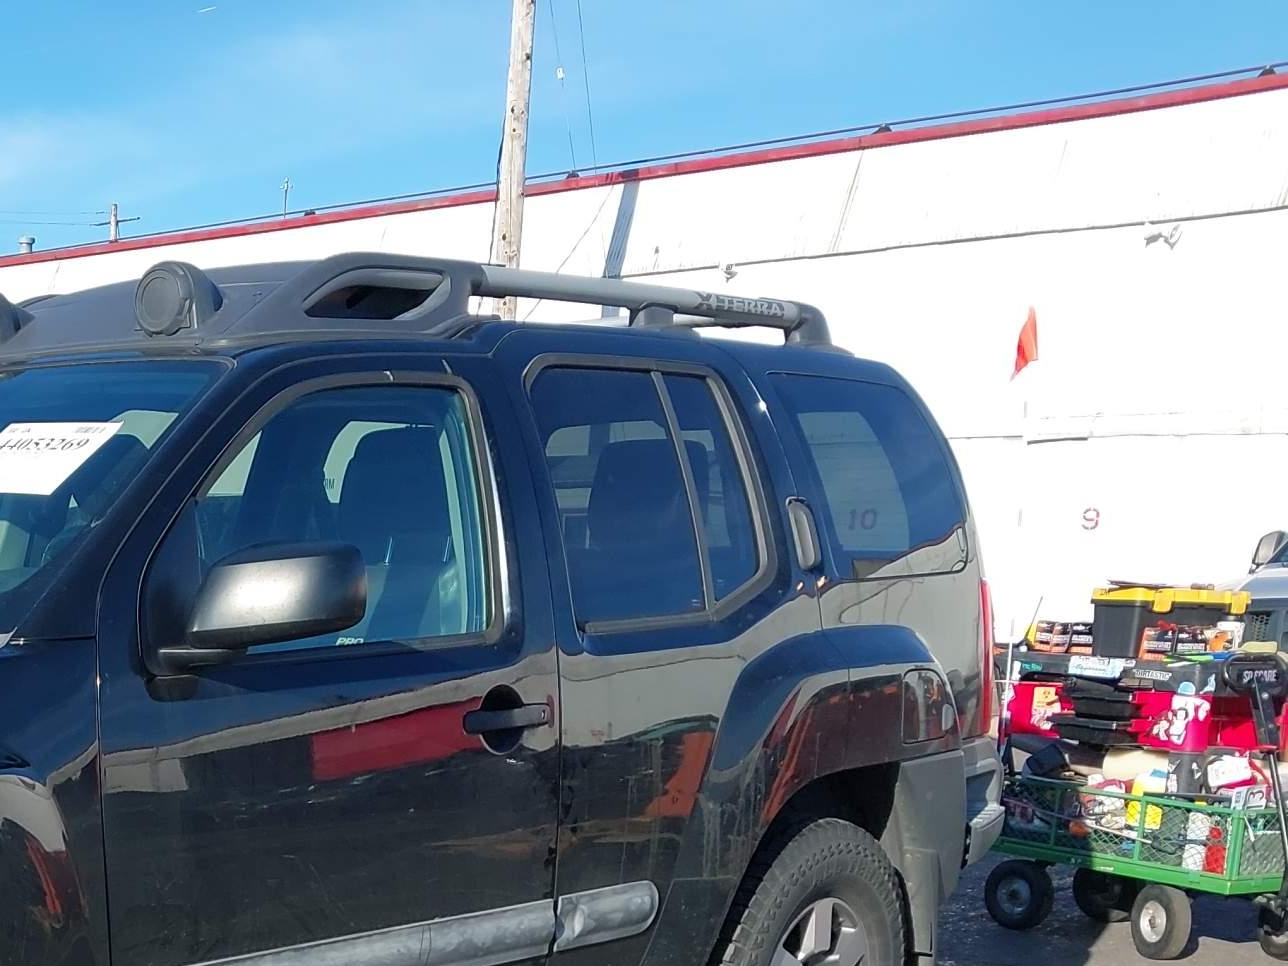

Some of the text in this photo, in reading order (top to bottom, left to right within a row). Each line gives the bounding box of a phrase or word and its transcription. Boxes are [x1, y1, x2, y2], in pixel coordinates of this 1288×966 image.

[695, 291, 786, 318] XTERRA
[848, 508, 878, 531] 10
[1081, 507, 1100, 530] 9
